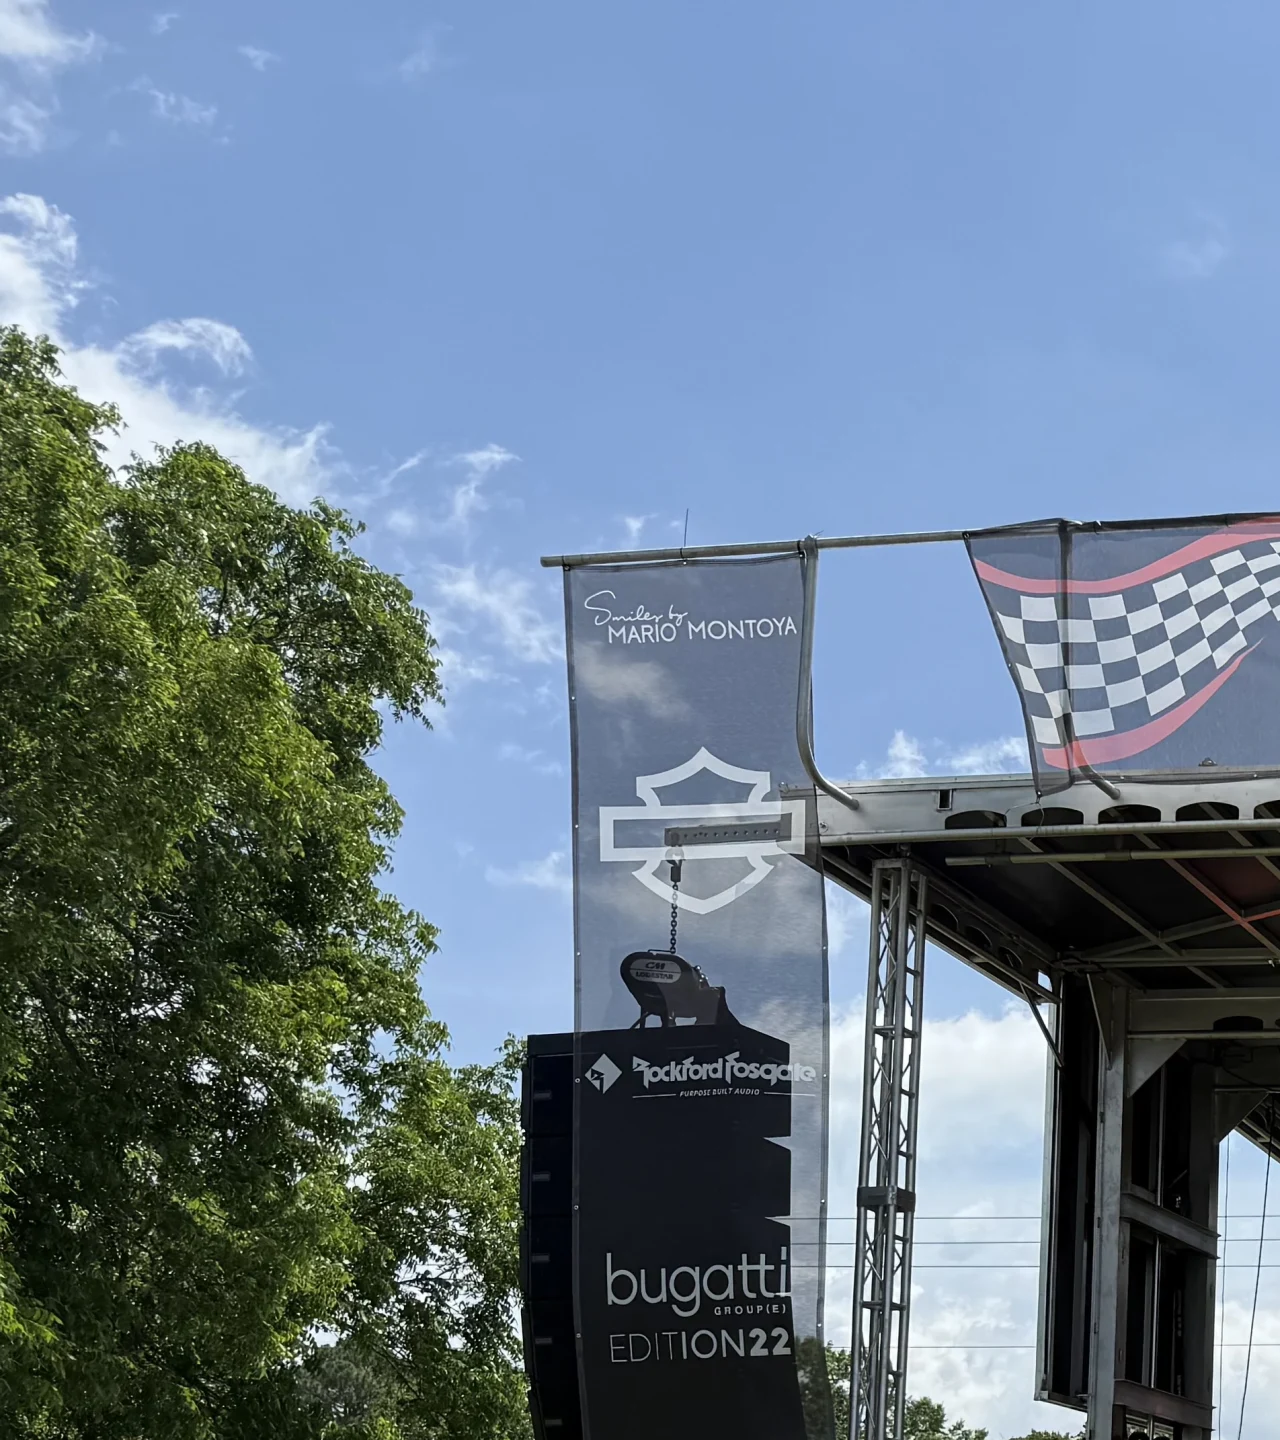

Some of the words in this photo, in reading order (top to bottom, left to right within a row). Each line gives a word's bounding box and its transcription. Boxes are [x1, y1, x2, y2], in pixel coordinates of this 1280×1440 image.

[584, 590, 663, 625] Smiles
[668, 604, 688, 627] by
[608, 622, 677, 644] MARIO
[687, 616, 798, 641] MONTOYA
[632, 1054, 723, 1088] Rockford
[725, 1051, 817, 1087] Fosgate
[679, 1089, 711, 1098] PURPOSE
[712, 1087, 733, 1096] BUILT
[734, 1087, 760, 1096] AUDIO
[606, 1246, 788, 1318] bugatti
[714, 1303, 787, 1316] GROUP(E)
[609, 1326, 792, 1363] EDITION22
